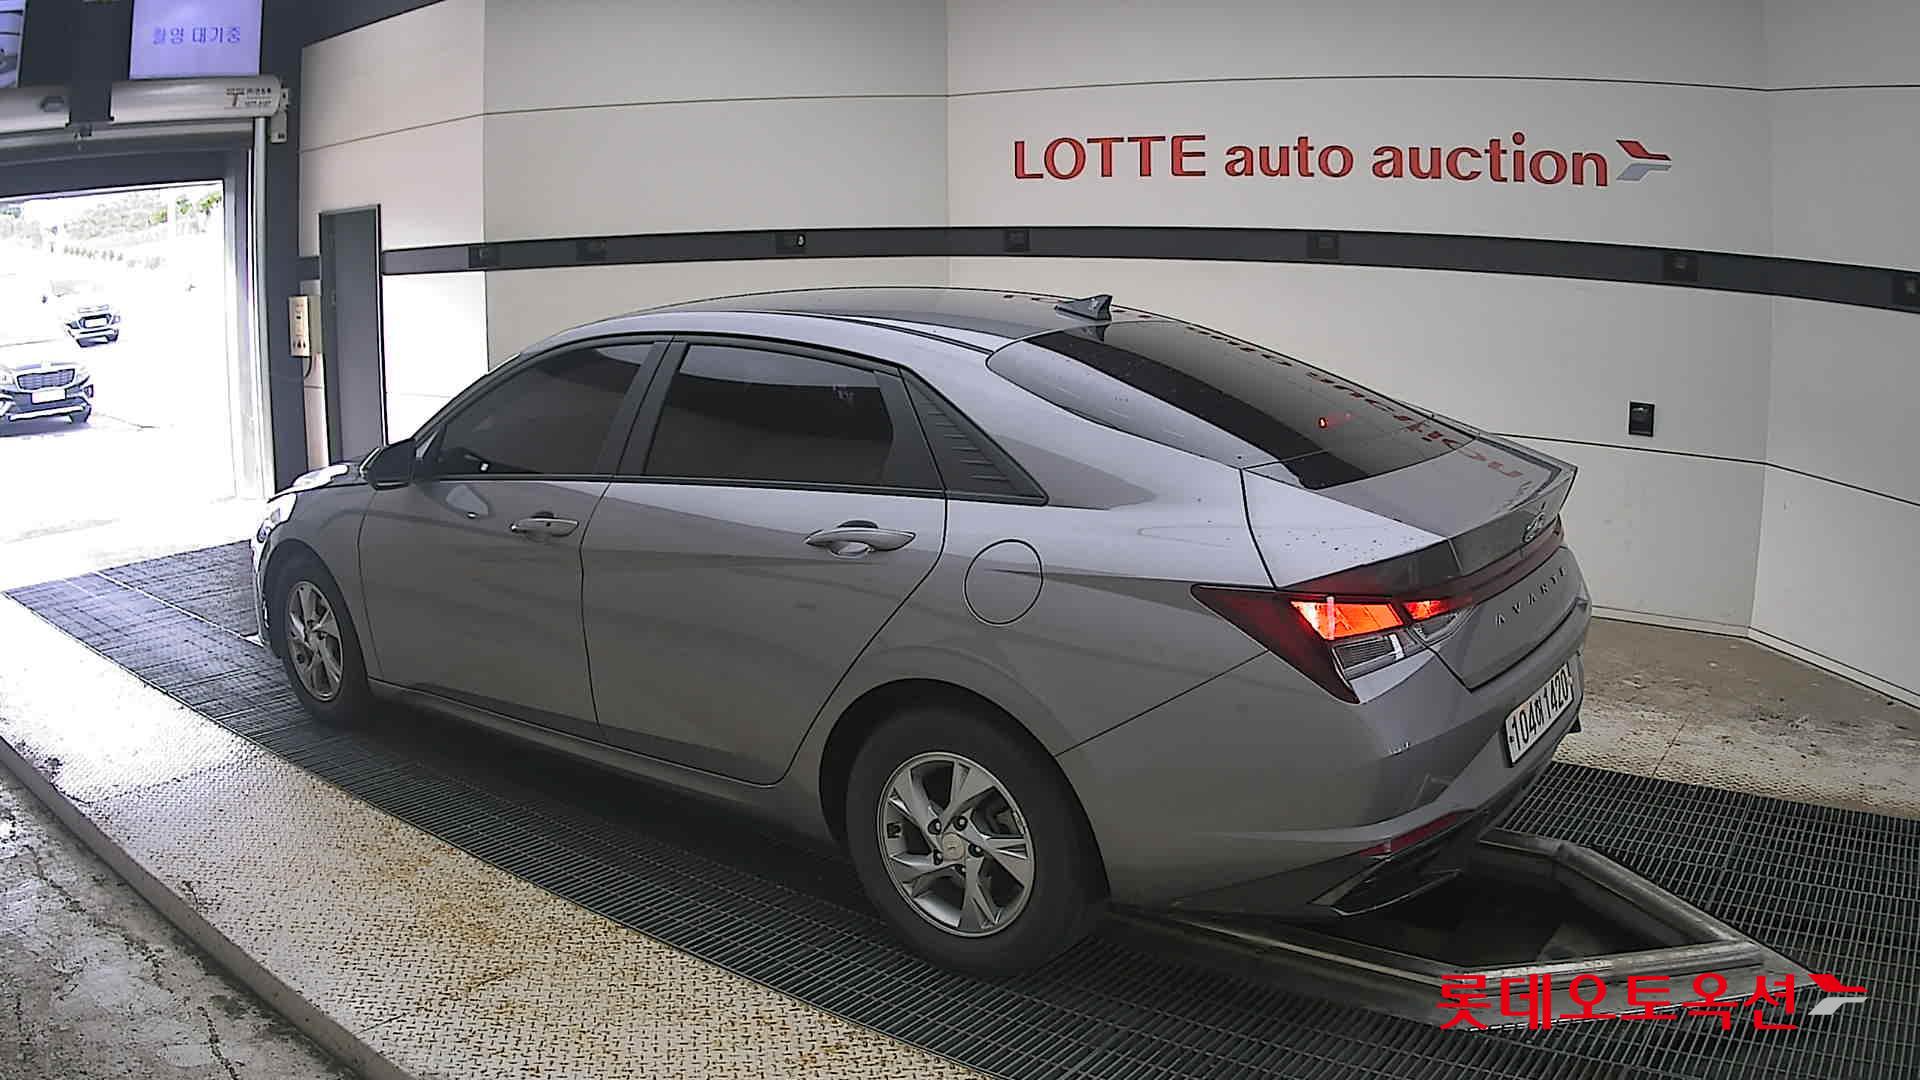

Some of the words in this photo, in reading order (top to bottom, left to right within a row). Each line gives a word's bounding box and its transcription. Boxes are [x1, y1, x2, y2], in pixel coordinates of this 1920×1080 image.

[192, 26, 241, 44] 대기중
[1014, 134, 1206, 180] LOTTE
[1224, 135, 1355, 178] auto
[1371, 131, 1609, 187] auction
